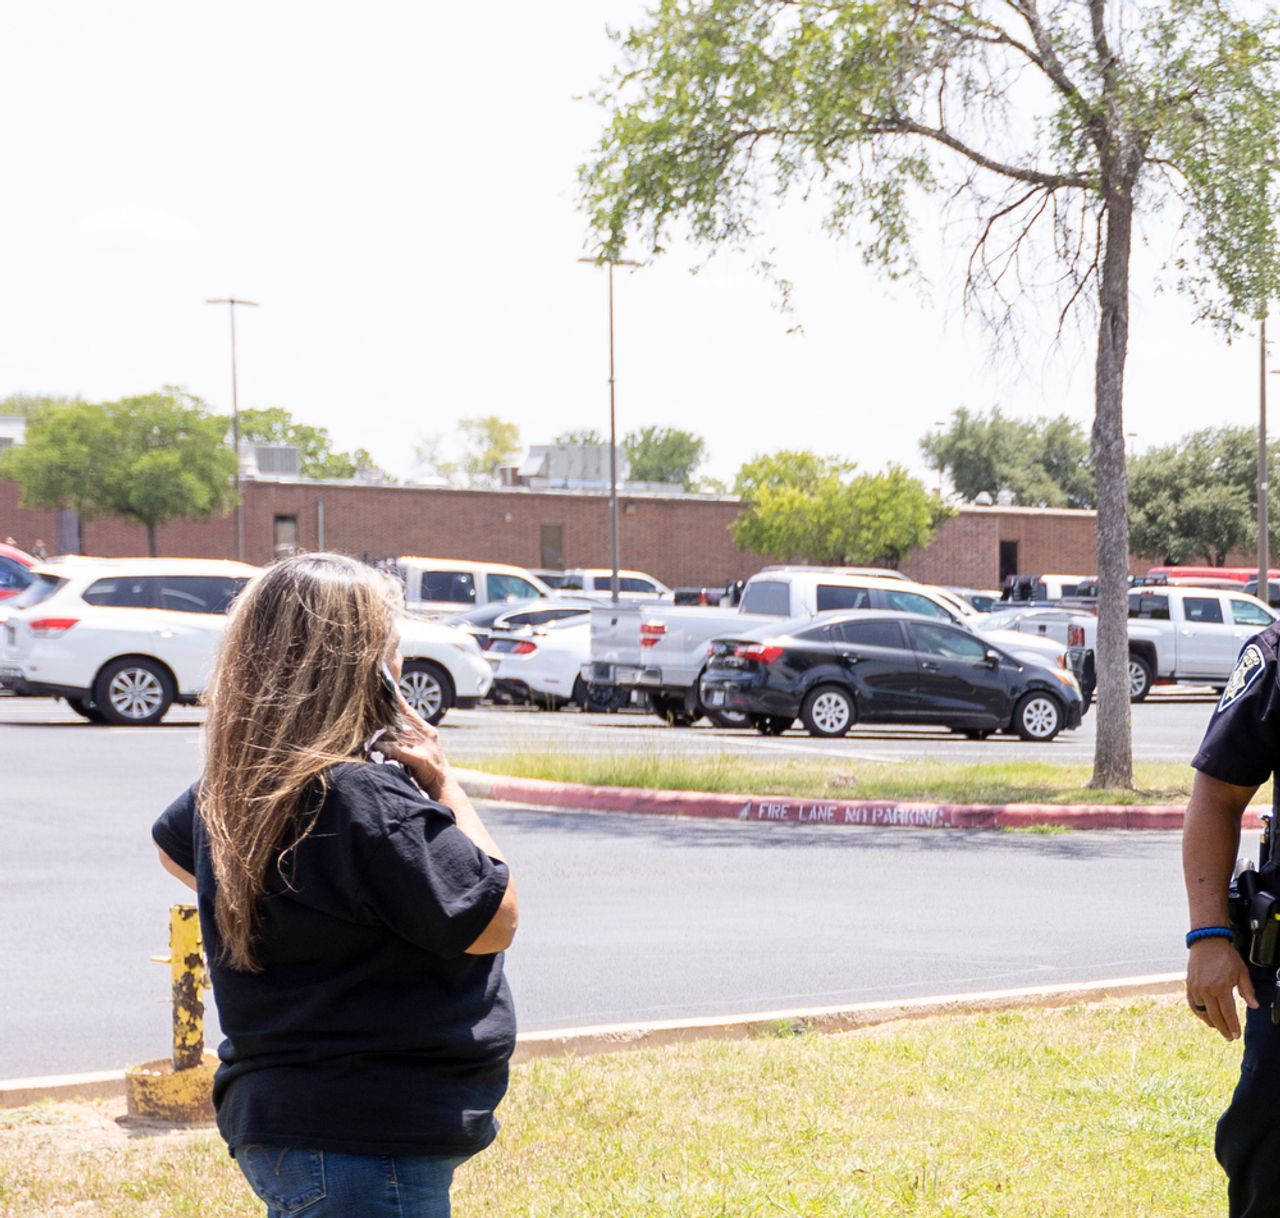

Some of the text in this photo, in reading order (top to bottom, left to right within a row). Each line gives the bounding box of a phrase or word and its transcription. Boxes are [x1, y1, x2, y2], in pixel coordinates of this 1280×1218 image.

[758, 803, 791, 820] FIRE
[799, 805, 838, 822] LANE
[844, 807, 868, 824] NO
